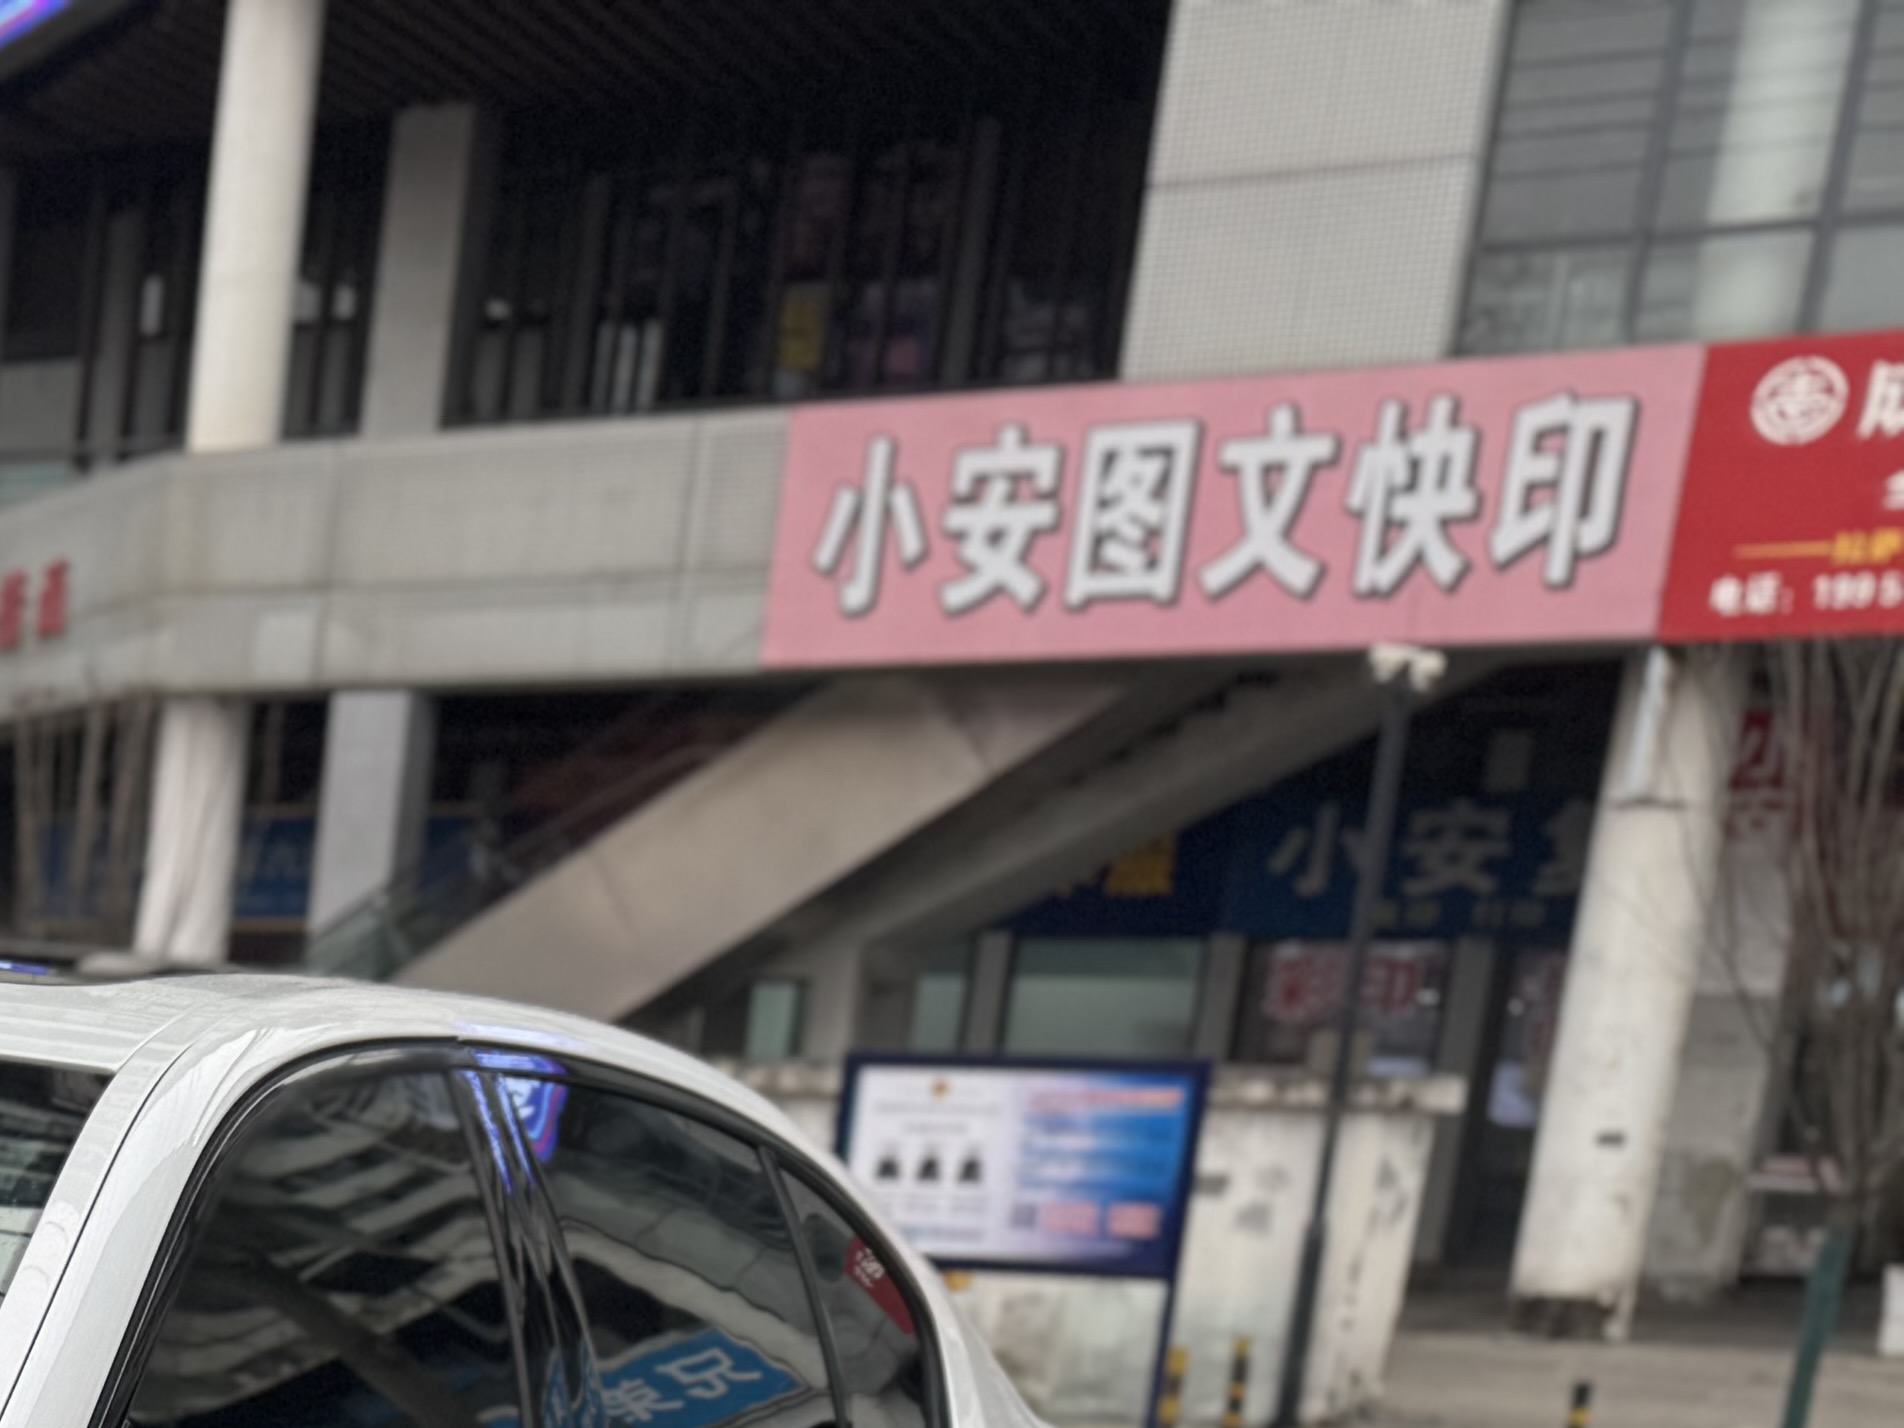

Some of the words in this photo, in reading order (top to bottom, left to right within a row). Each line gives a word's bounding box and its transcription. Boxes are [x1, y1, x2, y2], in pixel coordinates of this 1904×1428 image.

[812, 394, 1638, 618] 小安图文快印
